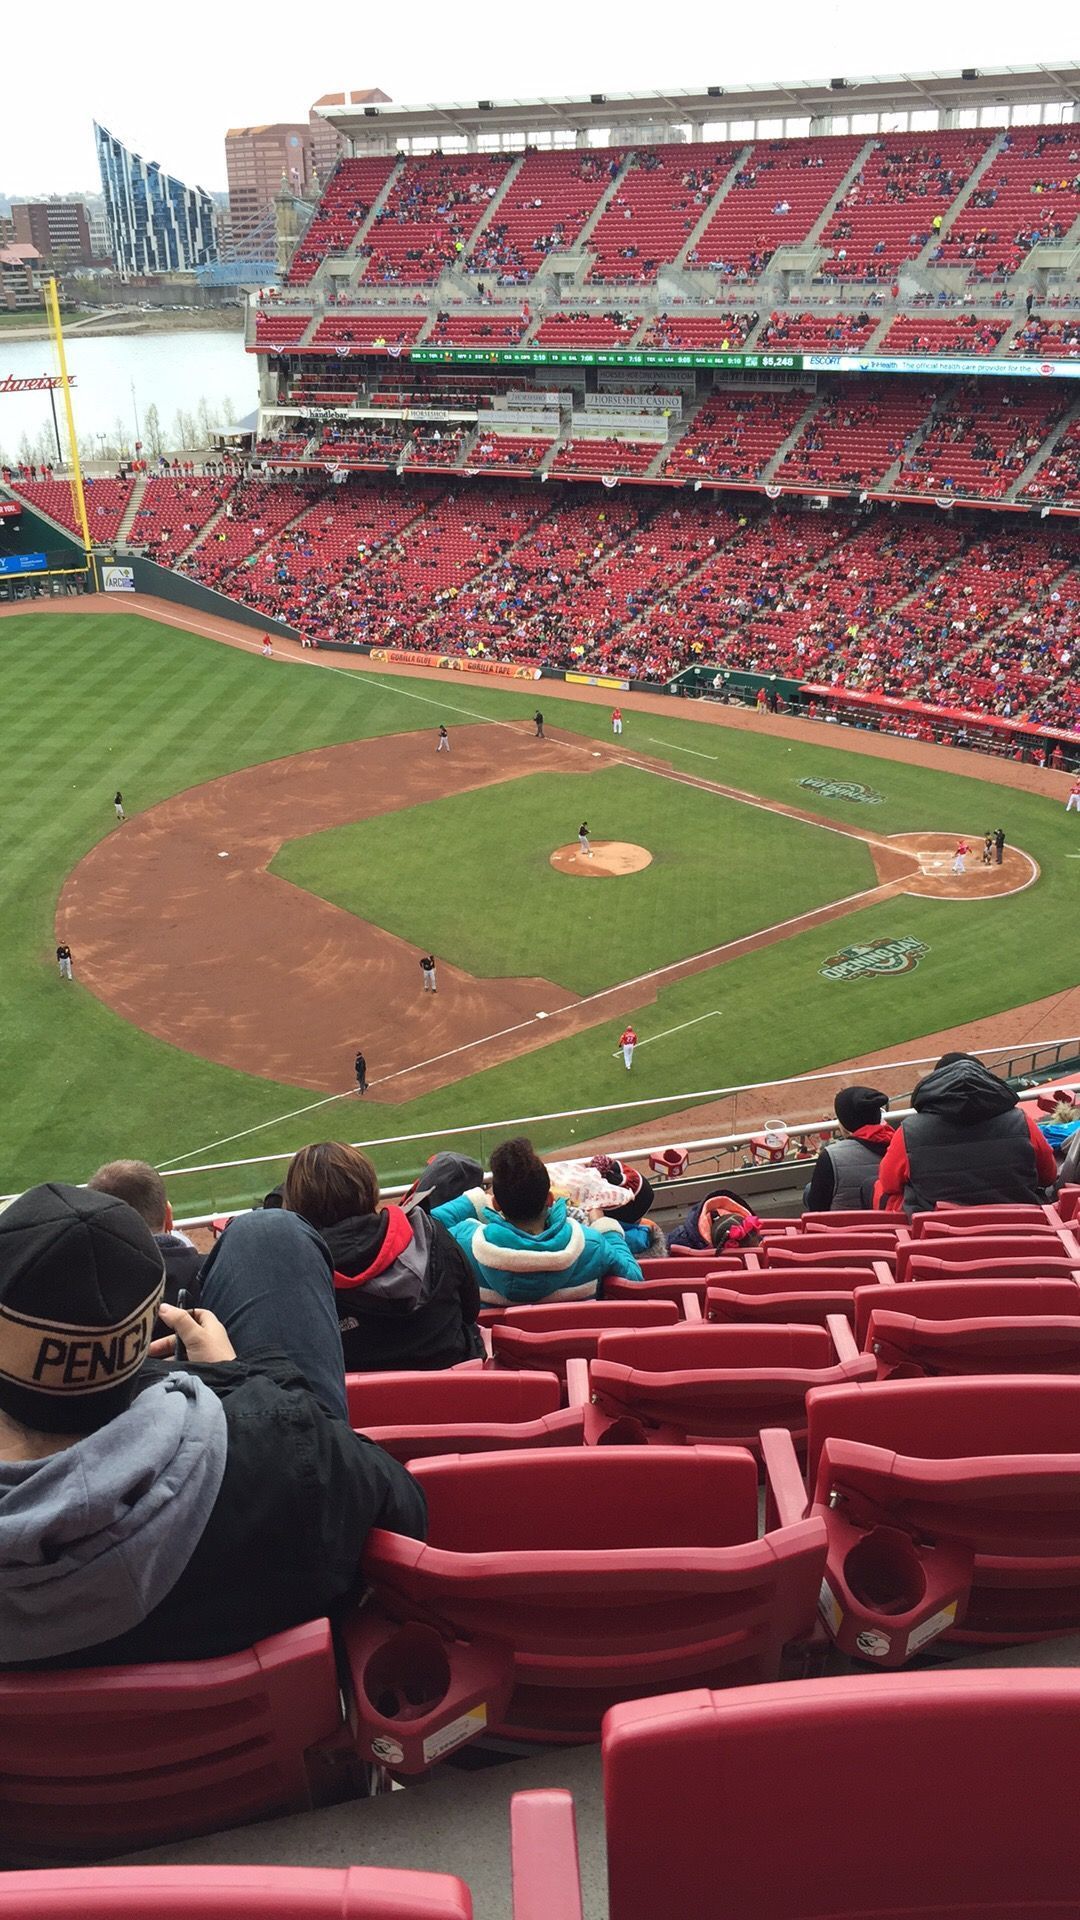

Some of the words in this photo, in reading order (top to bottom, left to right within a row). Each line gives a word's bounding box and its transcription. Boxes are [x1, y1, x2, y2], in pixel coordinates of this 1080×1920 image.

[728, 357, 742, 365] 9:10
[762, 356, 794, 367] $5,248
[809, 356, 841, 366] ESCORT
[915, 361, 938, 370] official
[977, 364, 1007, 374] provider
[1019, 364, 1032, 372] the
[646, 397, 680, 406] CASINO
[309, 408, 348, 419] handlebar
[390, 653, 416, 664] GORILLA
[415, 656, 432, 665] GLUE
[467, 662, 494, 673] GORILLA
[495, 665, 511, 676] TAPE
[821, 947, 895, 979] OPENING
[886, 936, 921, 953] DAY
